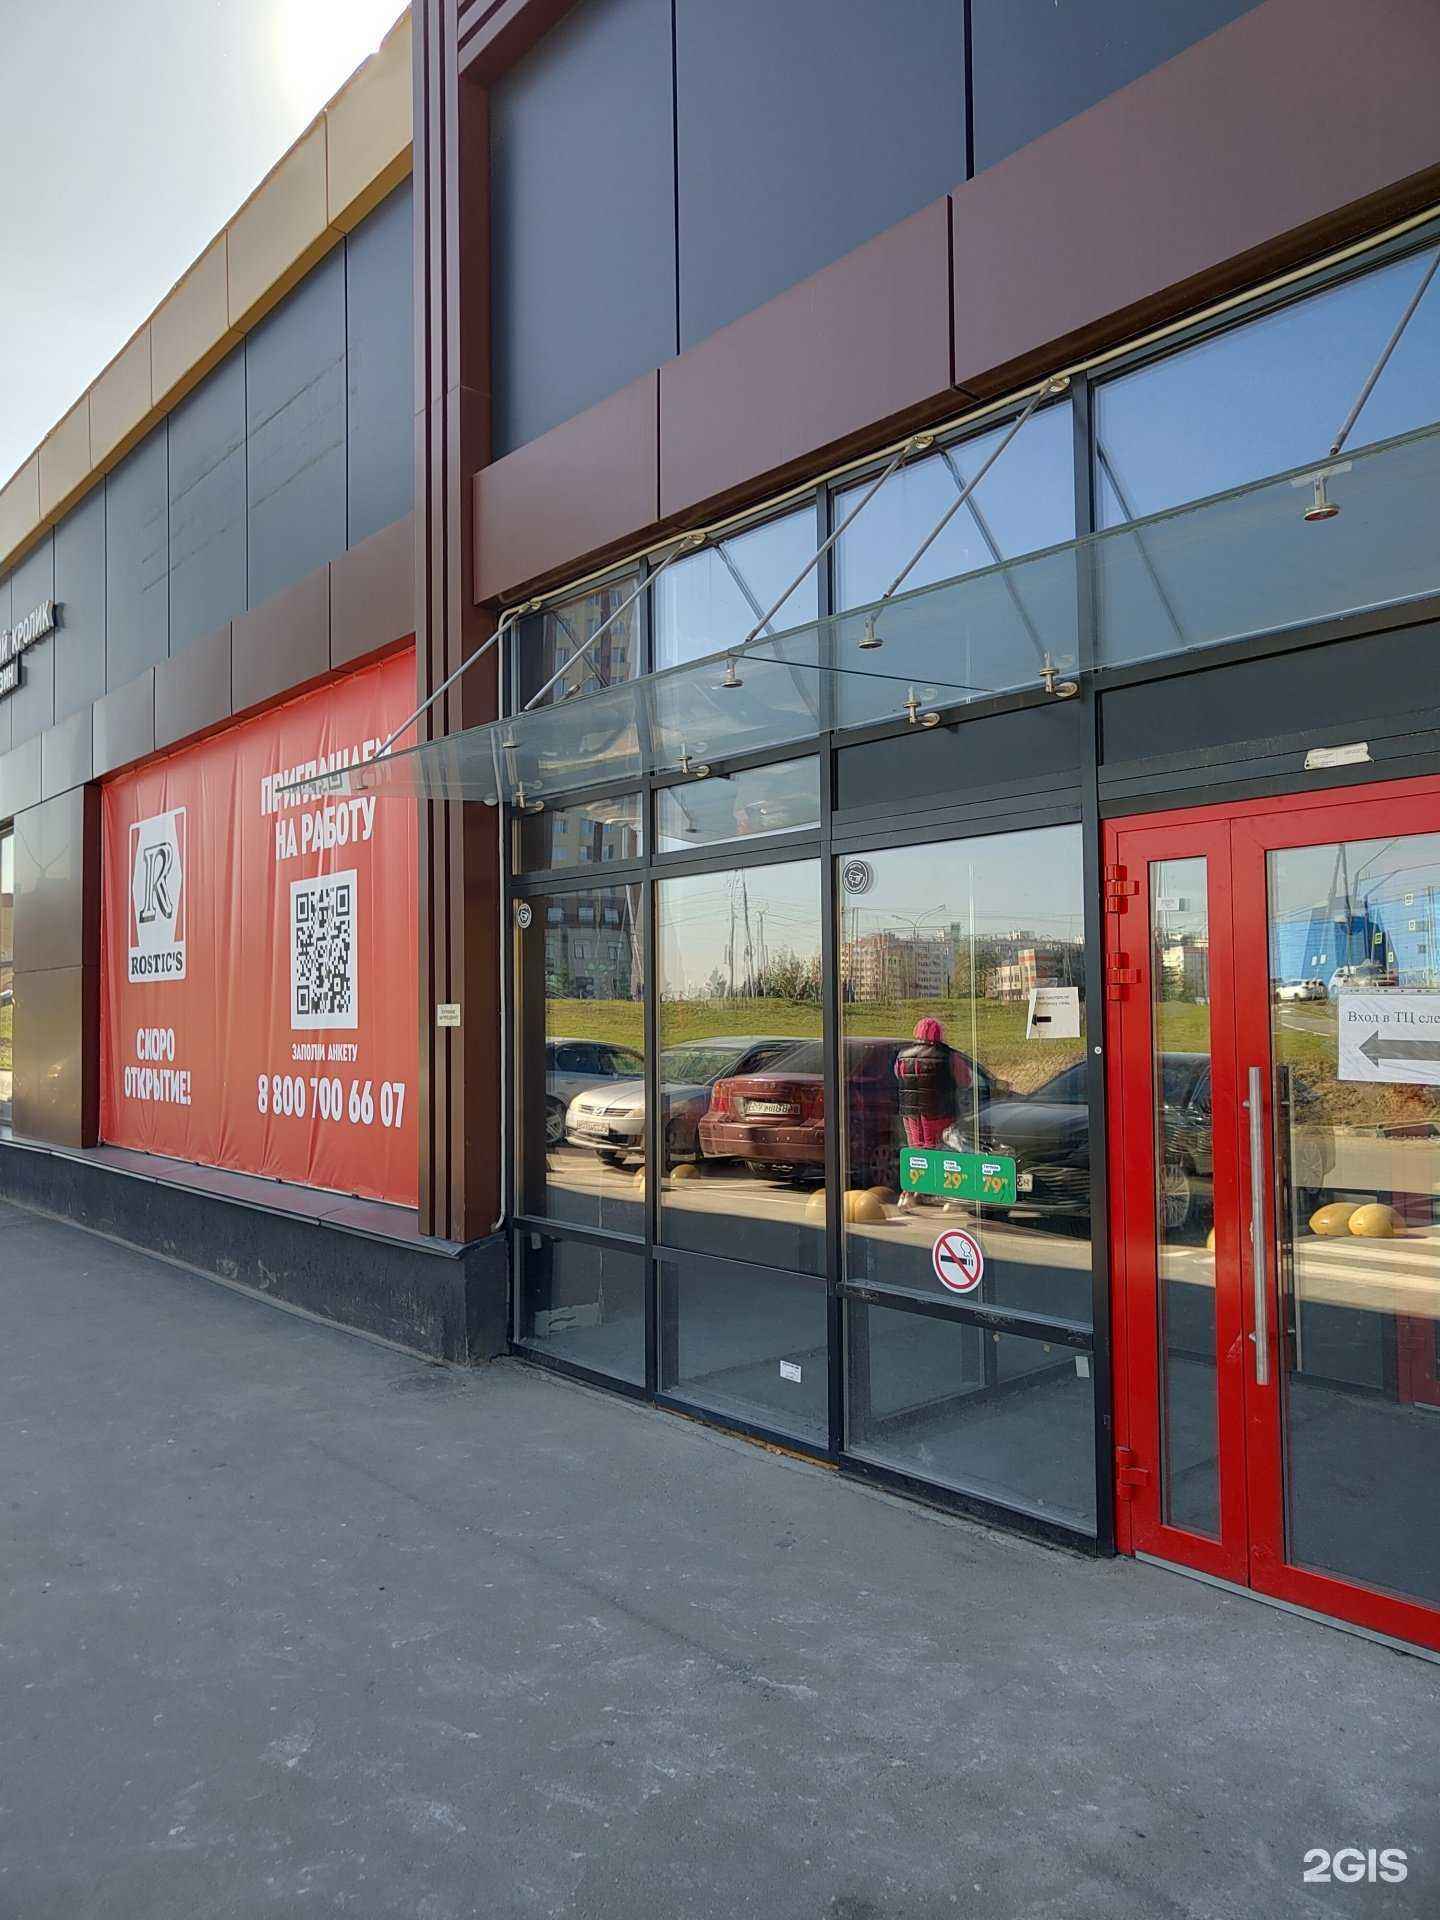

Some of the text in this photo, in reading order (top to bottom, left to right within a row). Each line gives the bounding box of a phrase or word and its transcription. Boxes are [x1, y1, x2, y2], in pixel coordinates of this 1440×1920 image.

[12, 599, 49, 654] КРОЛИК
[275, 796, 376, 860] НА РАБОТУ
[139, 842, 173, 923] R
[131, 951, 183, 975] ROSTIC'S
[1348, 1011, 1379, 1024] Вход
[1383, 1014, 1390, 1023] в
[1394, 1011, 1415, 1025] ТЦ
[136, 1027, 176, 1062] СКОРО
[327, 1043, 358, 1062] АНКЕТУ
[124, 1066, 192, 1105] ОТКРЫТИЕ!
[257, 1074, 406, 1128] 8 800 700 66 07
